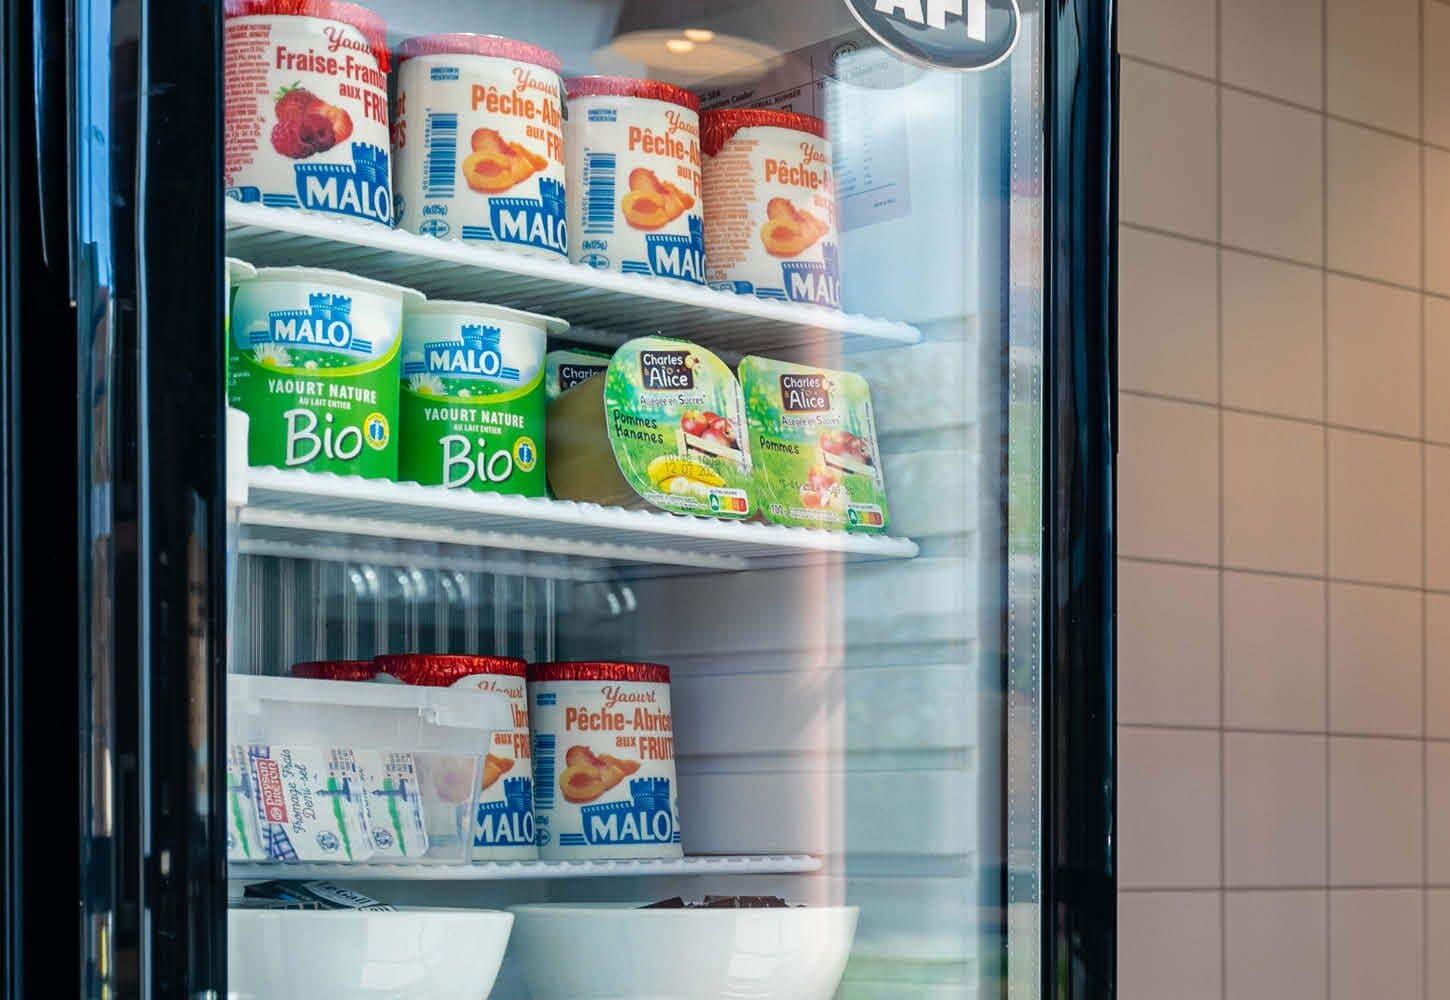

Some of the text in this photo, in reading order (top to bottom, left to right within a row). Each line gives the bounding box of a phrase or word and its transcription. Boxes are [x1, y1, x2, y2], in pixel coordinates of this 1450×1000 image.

[339, 83, 361, 100] aux
[526, 125, 545, 141] aux
[306, 176, 389, 222] MALO
[500, 209, 568, 253] MALO
[274, 319, 350, 347] MALO
[430, 349, 500, 376] MALO
[643, 353, 684, 366] Charles
[650, 368, 689, 388] Alice
[783, 376, 821, 389] Charles
[267, 379, 378, 405] YAOURT NATURE
[789, 391, 825, 409] Alice
[424, 407, 524, 429] YAOURT NATURE
[613, 409, 657, 429] Pommes
[283, 408, 363, 467] Bio
[759, 435, 800, 455] Pommes
[438, 434, 513, 489] Bio
[601, 686, 657, 709] Yaourt
[494, 733, 512, 744] aux
[615, 736, 636, 748] aux
[474, 811, 535, 843] MALO
[591, 810, 672, 843] MALO
